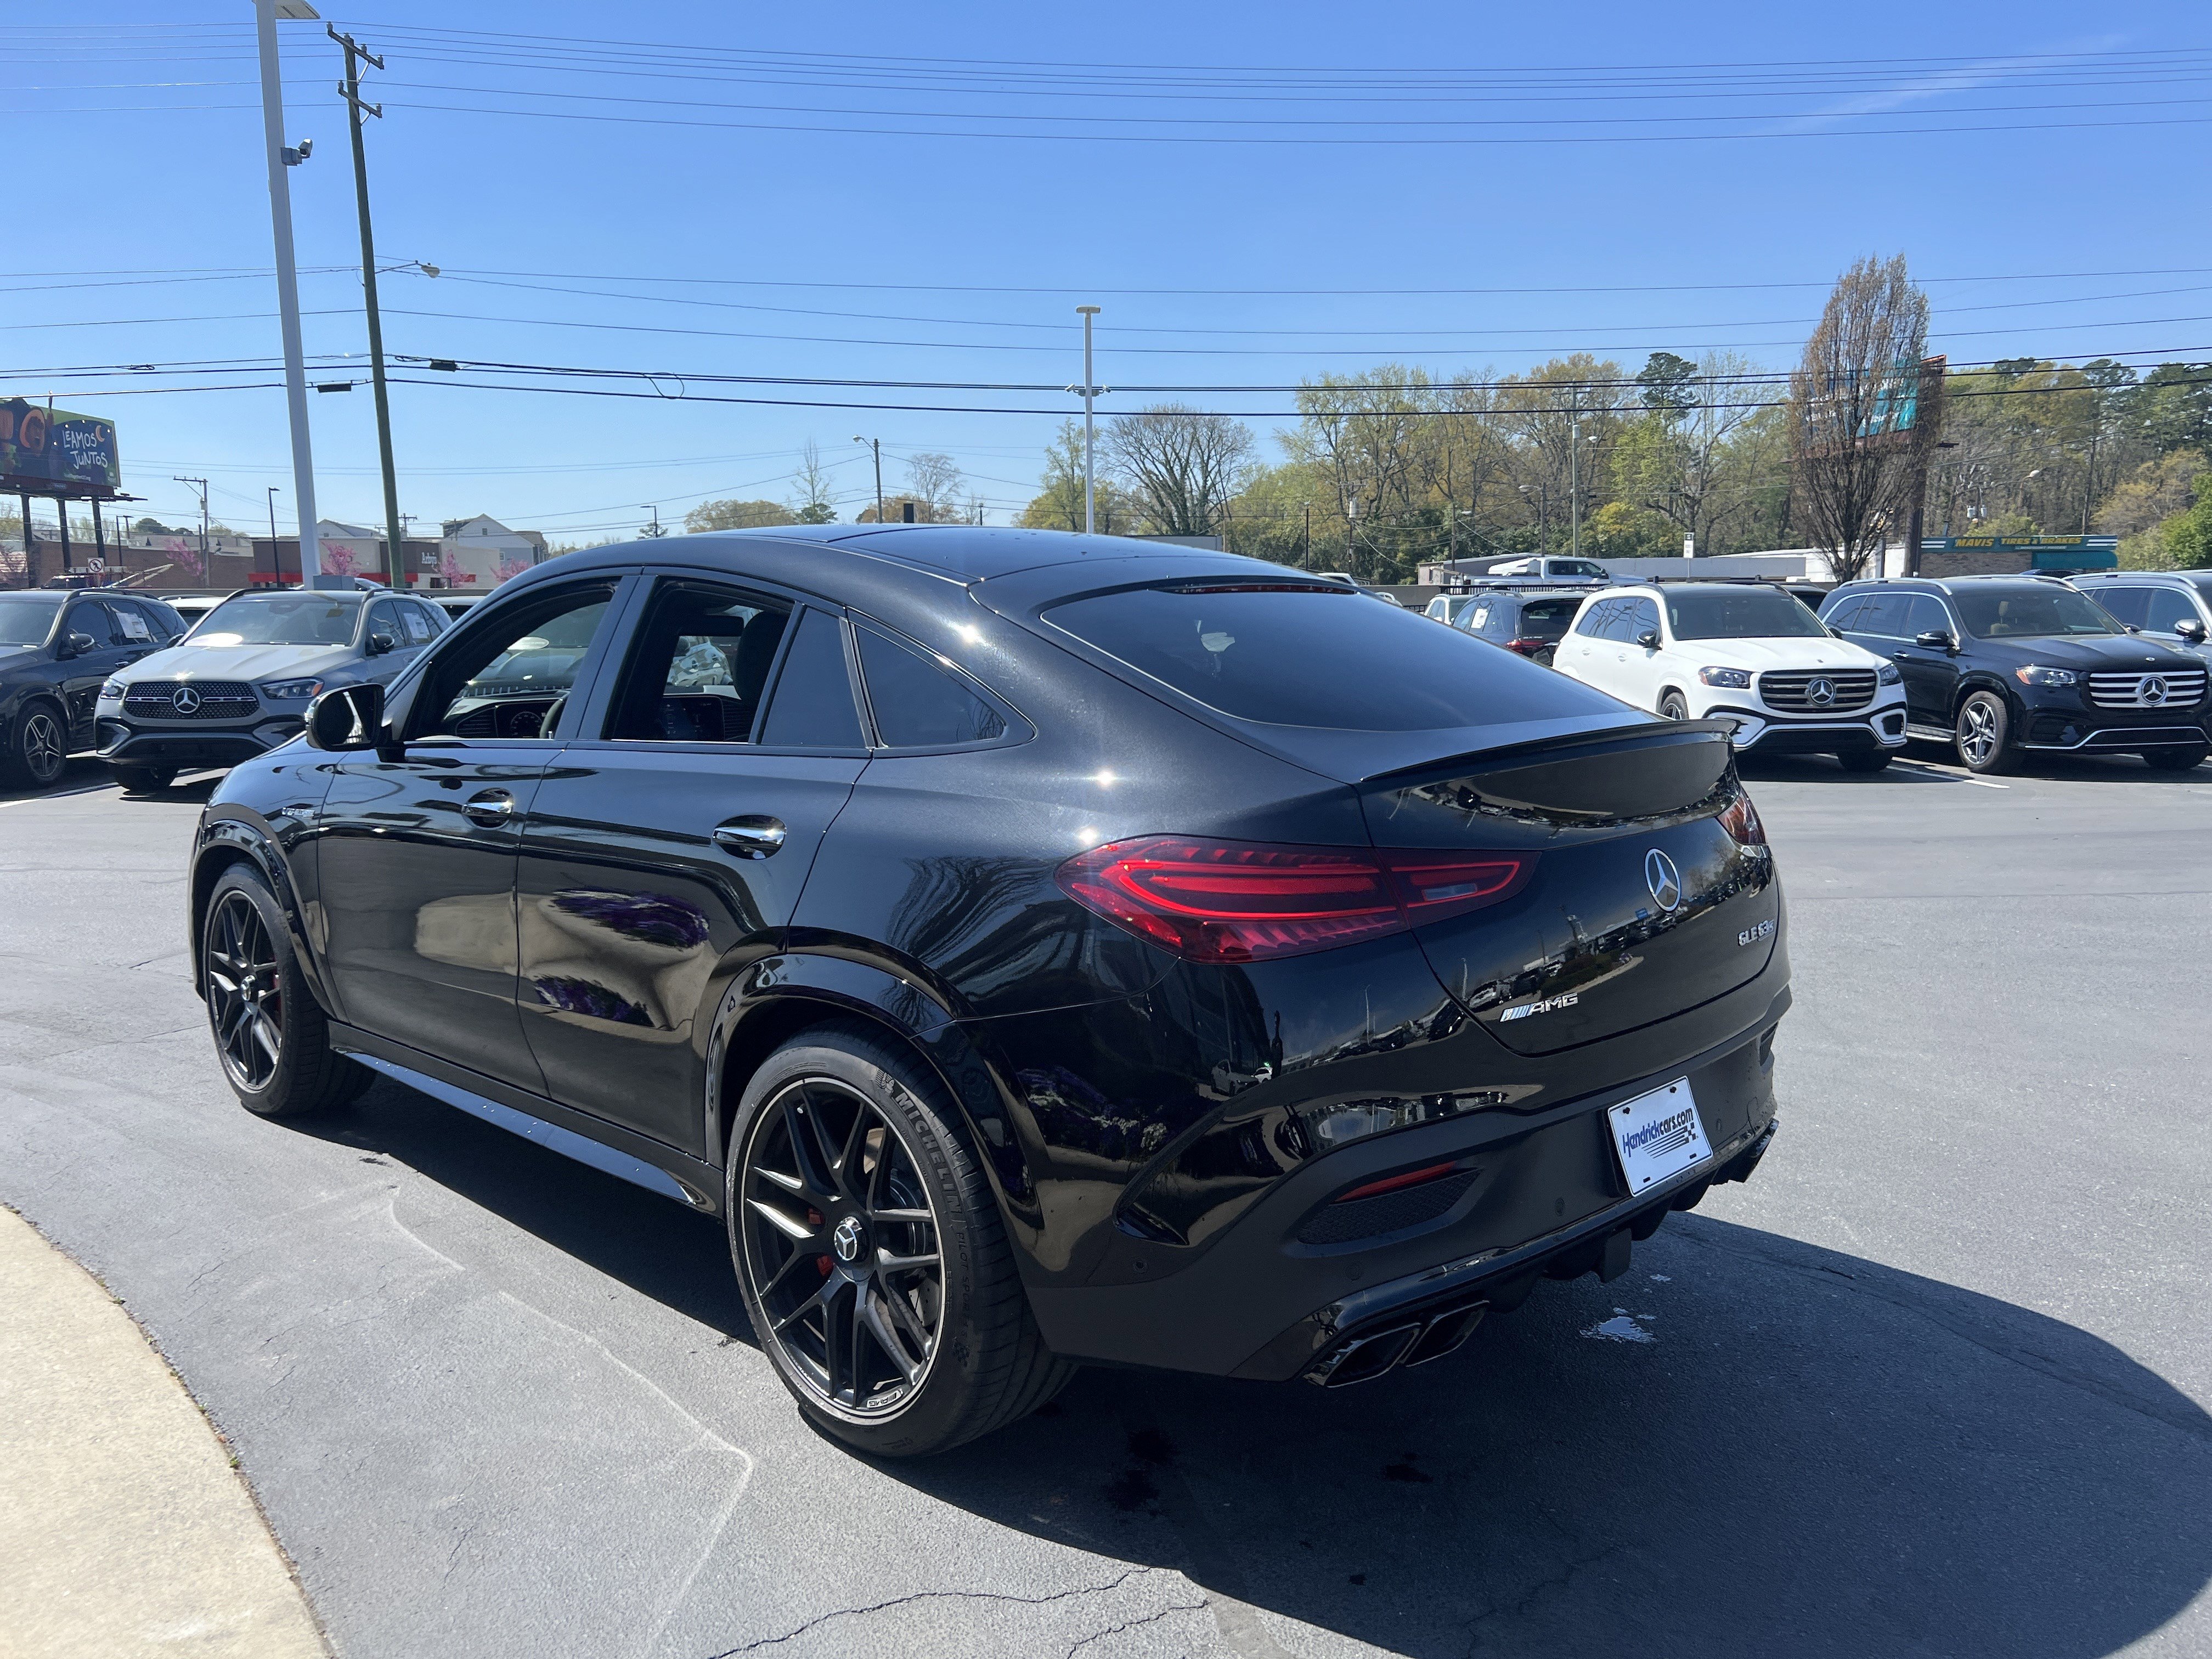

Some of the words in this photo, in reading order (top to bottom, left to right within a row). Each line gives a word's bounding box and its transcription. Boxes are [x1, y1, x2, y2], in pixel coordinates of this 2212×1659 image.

[62, 430, 97, 449] LEAMOS
[1955, 538, 1995, 547] MAVIS
[1527, 992, 1578, 1016] AMG
[1622, 1108, 1694, 1158] Hendrickcars.com
[895, 1092, 963, 1214] MICHELIN
